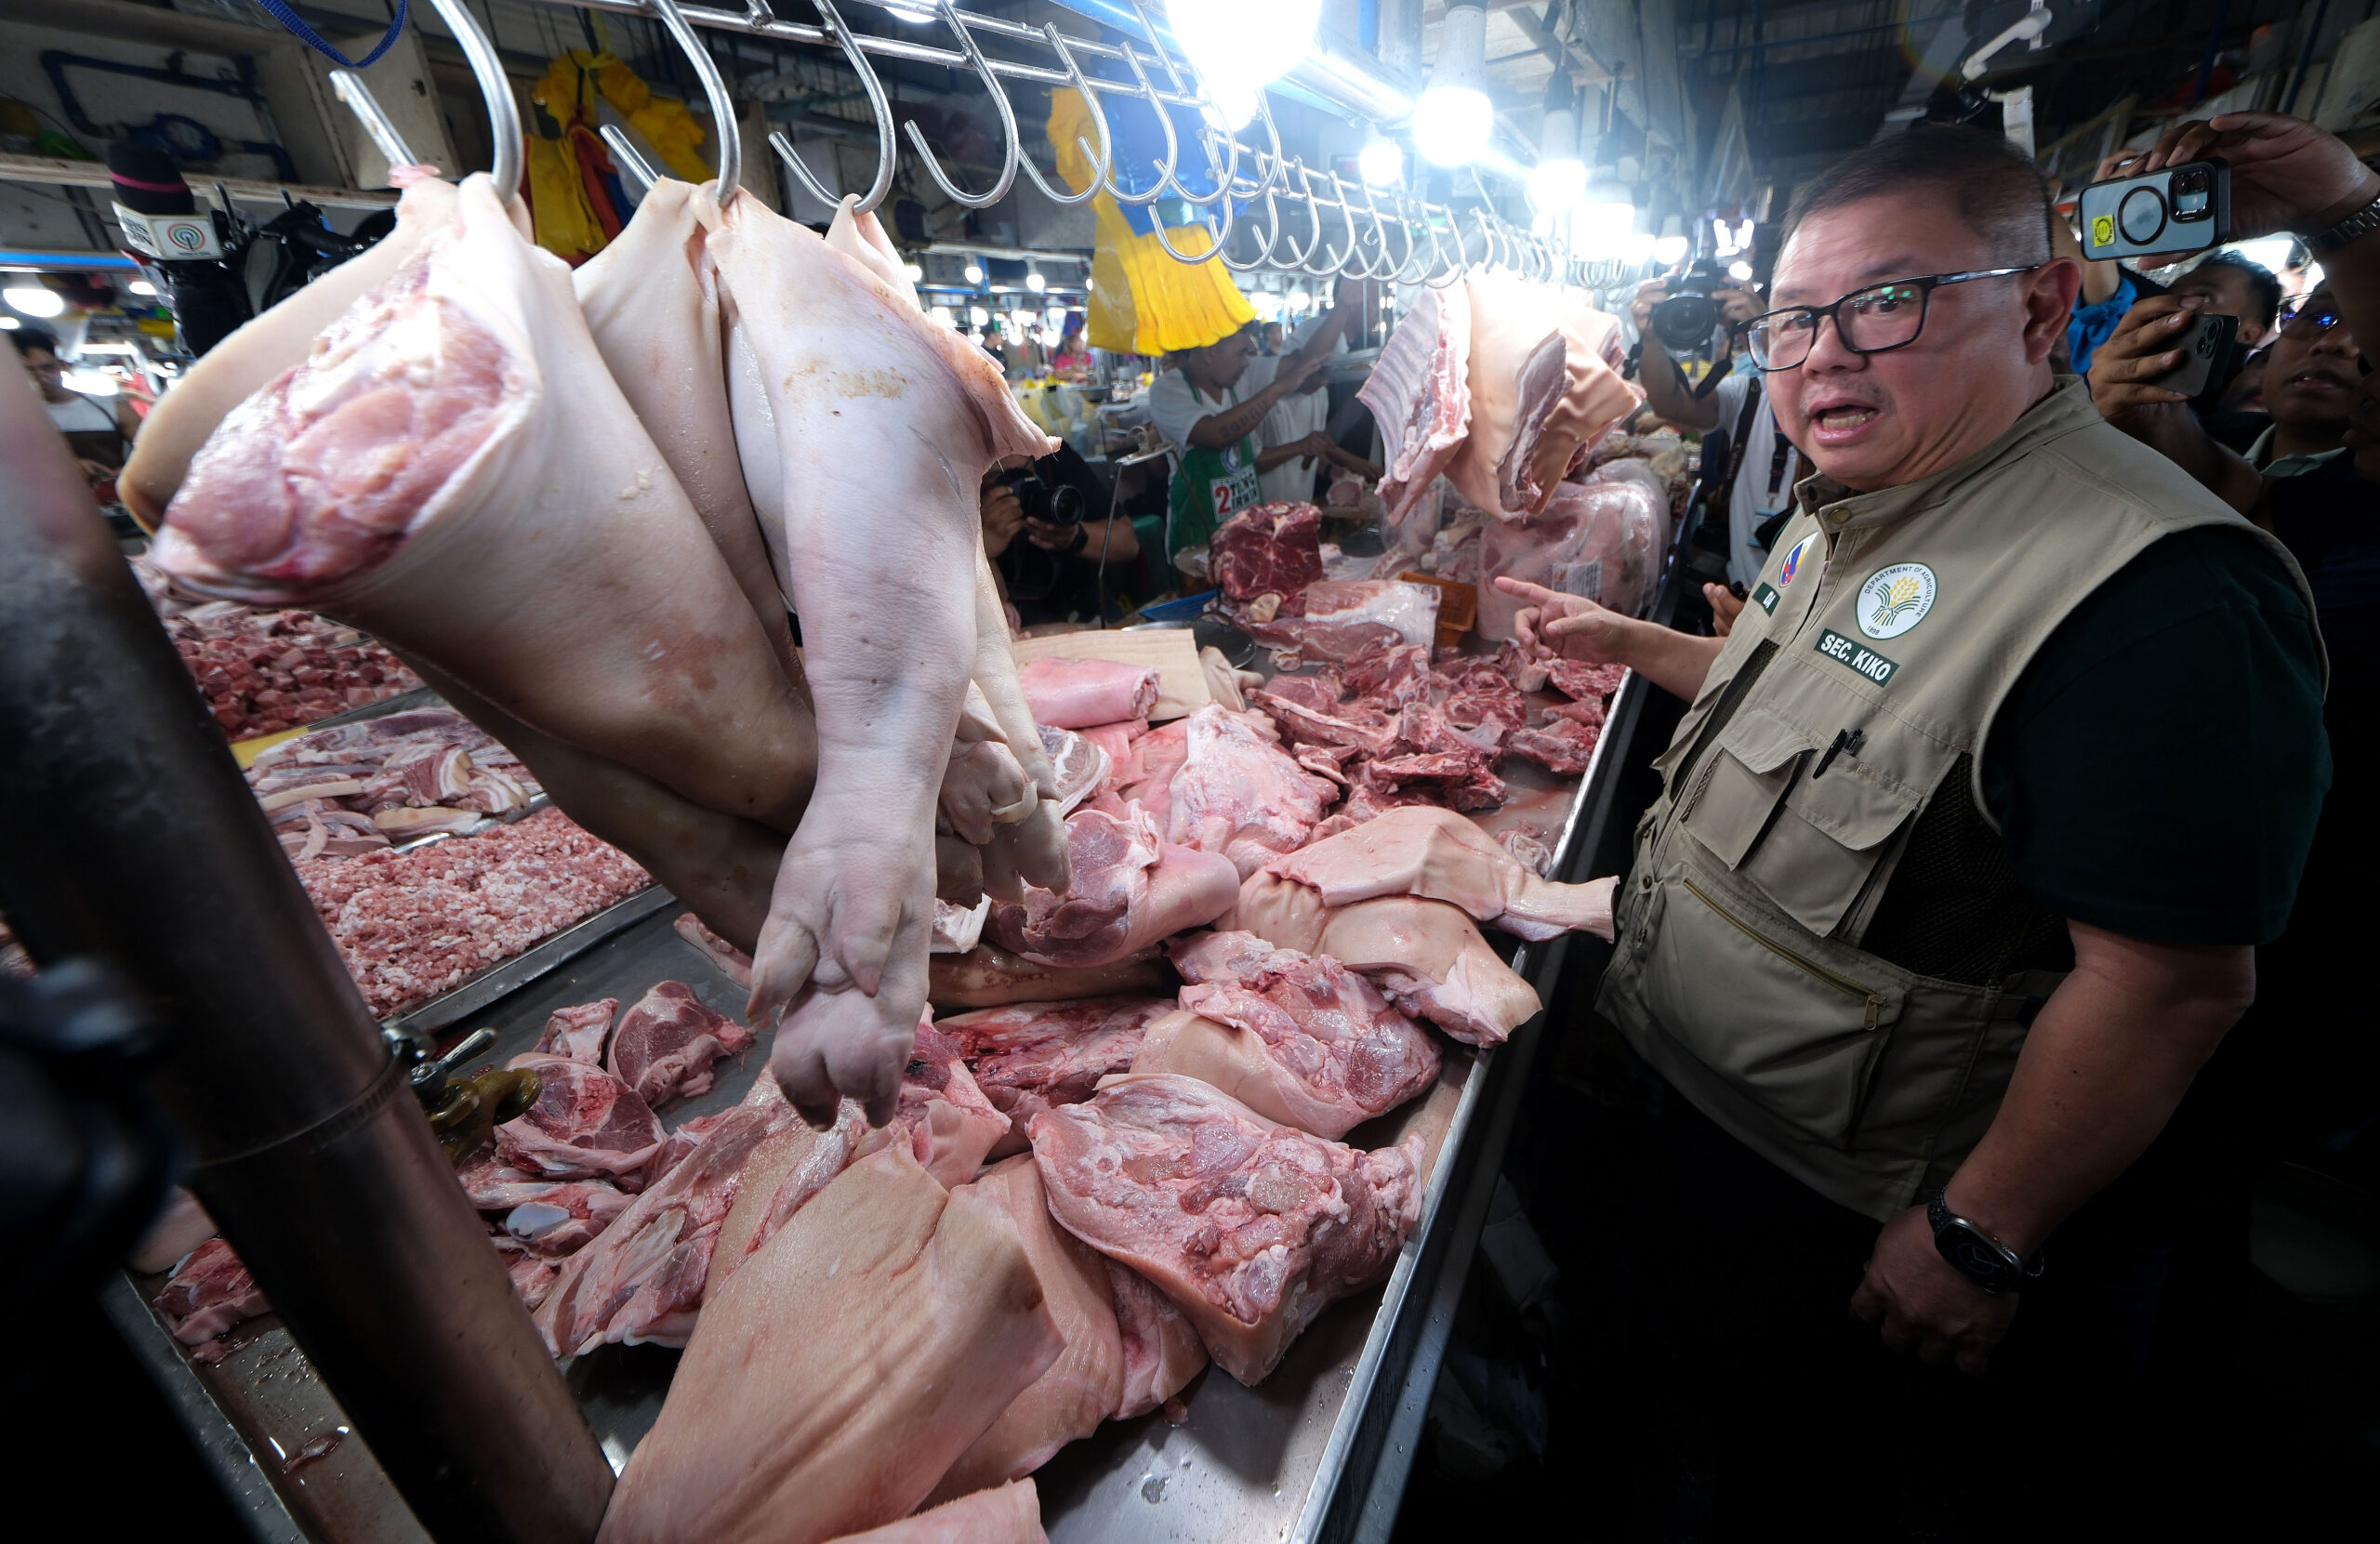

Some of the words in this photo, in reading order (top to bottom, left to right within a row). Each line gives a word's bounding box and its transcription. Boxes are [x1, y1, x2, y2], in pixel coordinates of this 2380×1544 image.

[1215, 485, 1231, 514] 2
[1864, 566, 1912, 594] DEPARTMENT
[1915, 571, 1932, 617] AGRICULTURE
[1867, 626, 1880, 636] 1898
[1821, 634, 1852, 662] SEC.
[1852, 650, 1892, 681] KIKO
